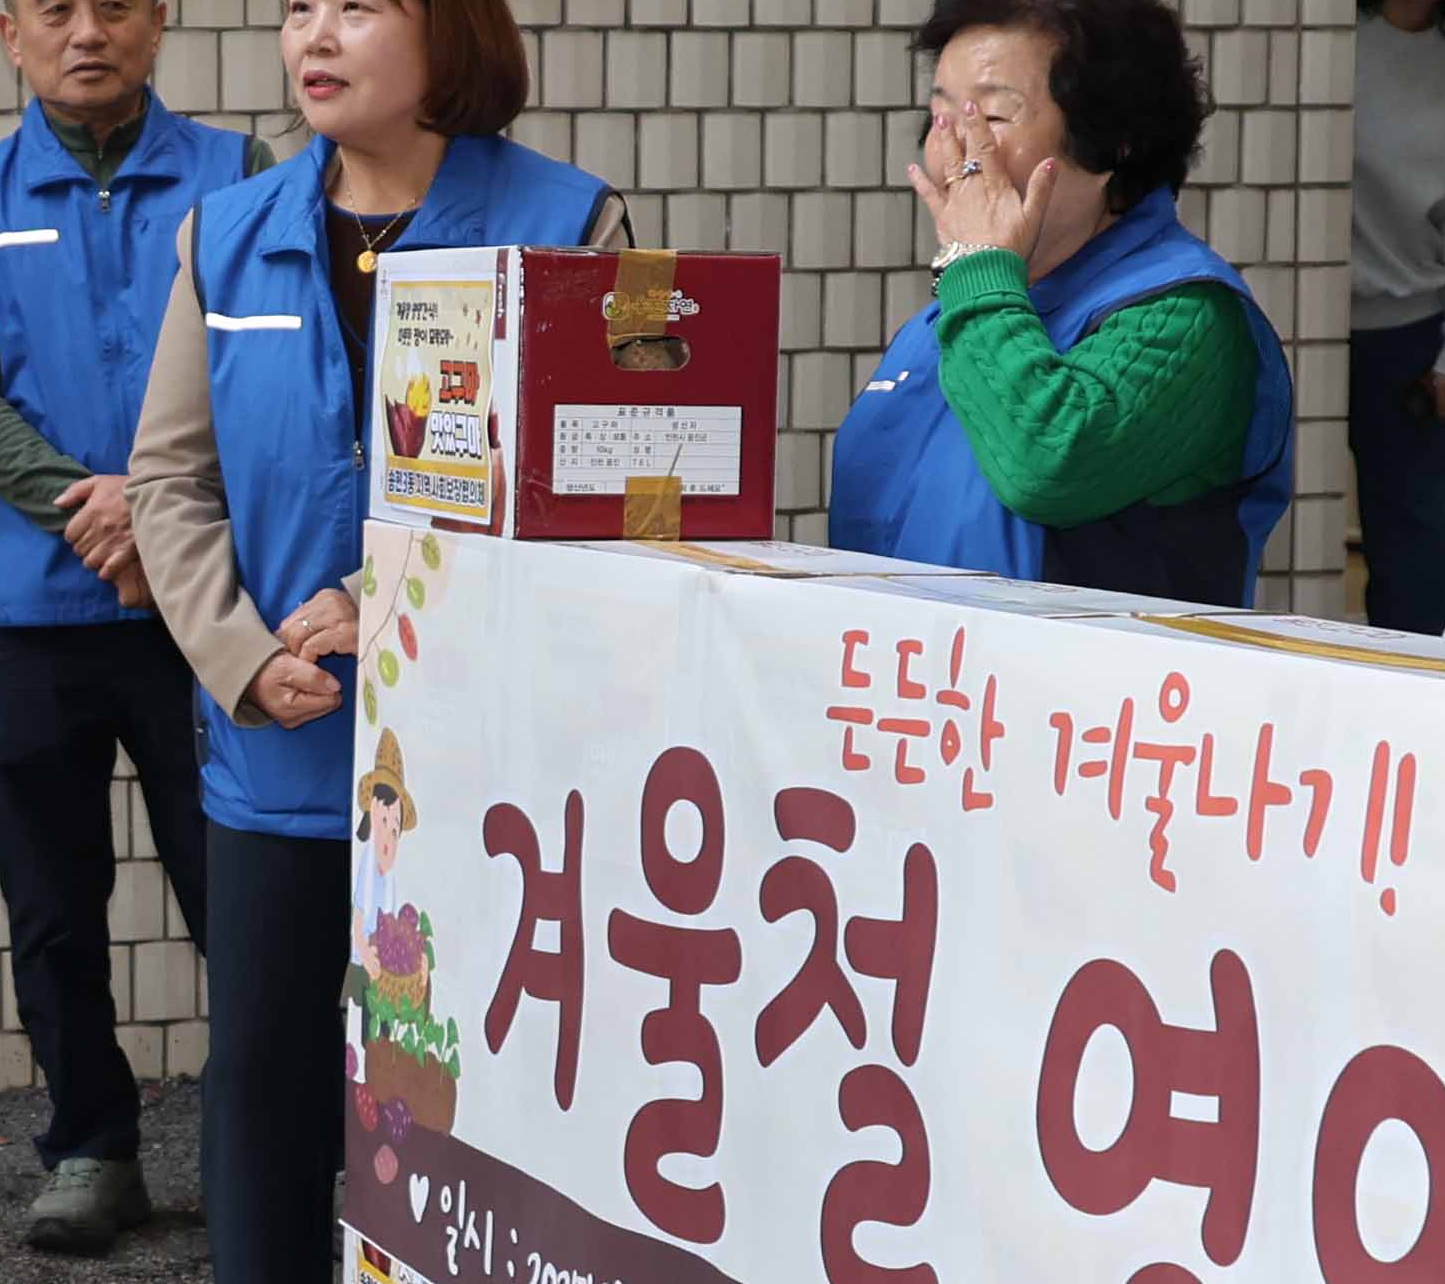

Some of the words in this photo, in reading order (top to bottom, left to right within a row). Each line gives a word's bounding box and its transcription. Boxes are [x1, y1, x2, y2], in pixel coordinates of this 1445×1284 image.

[439, 359, 481, 406] 고구마
[430, 410, 482, 459] 맛있구마
[826, 625, 1006, 812] 든든한
[1049, 671, 1419, 916] 겨울나기!!
[440, 1179, 494, 1276] 일시
